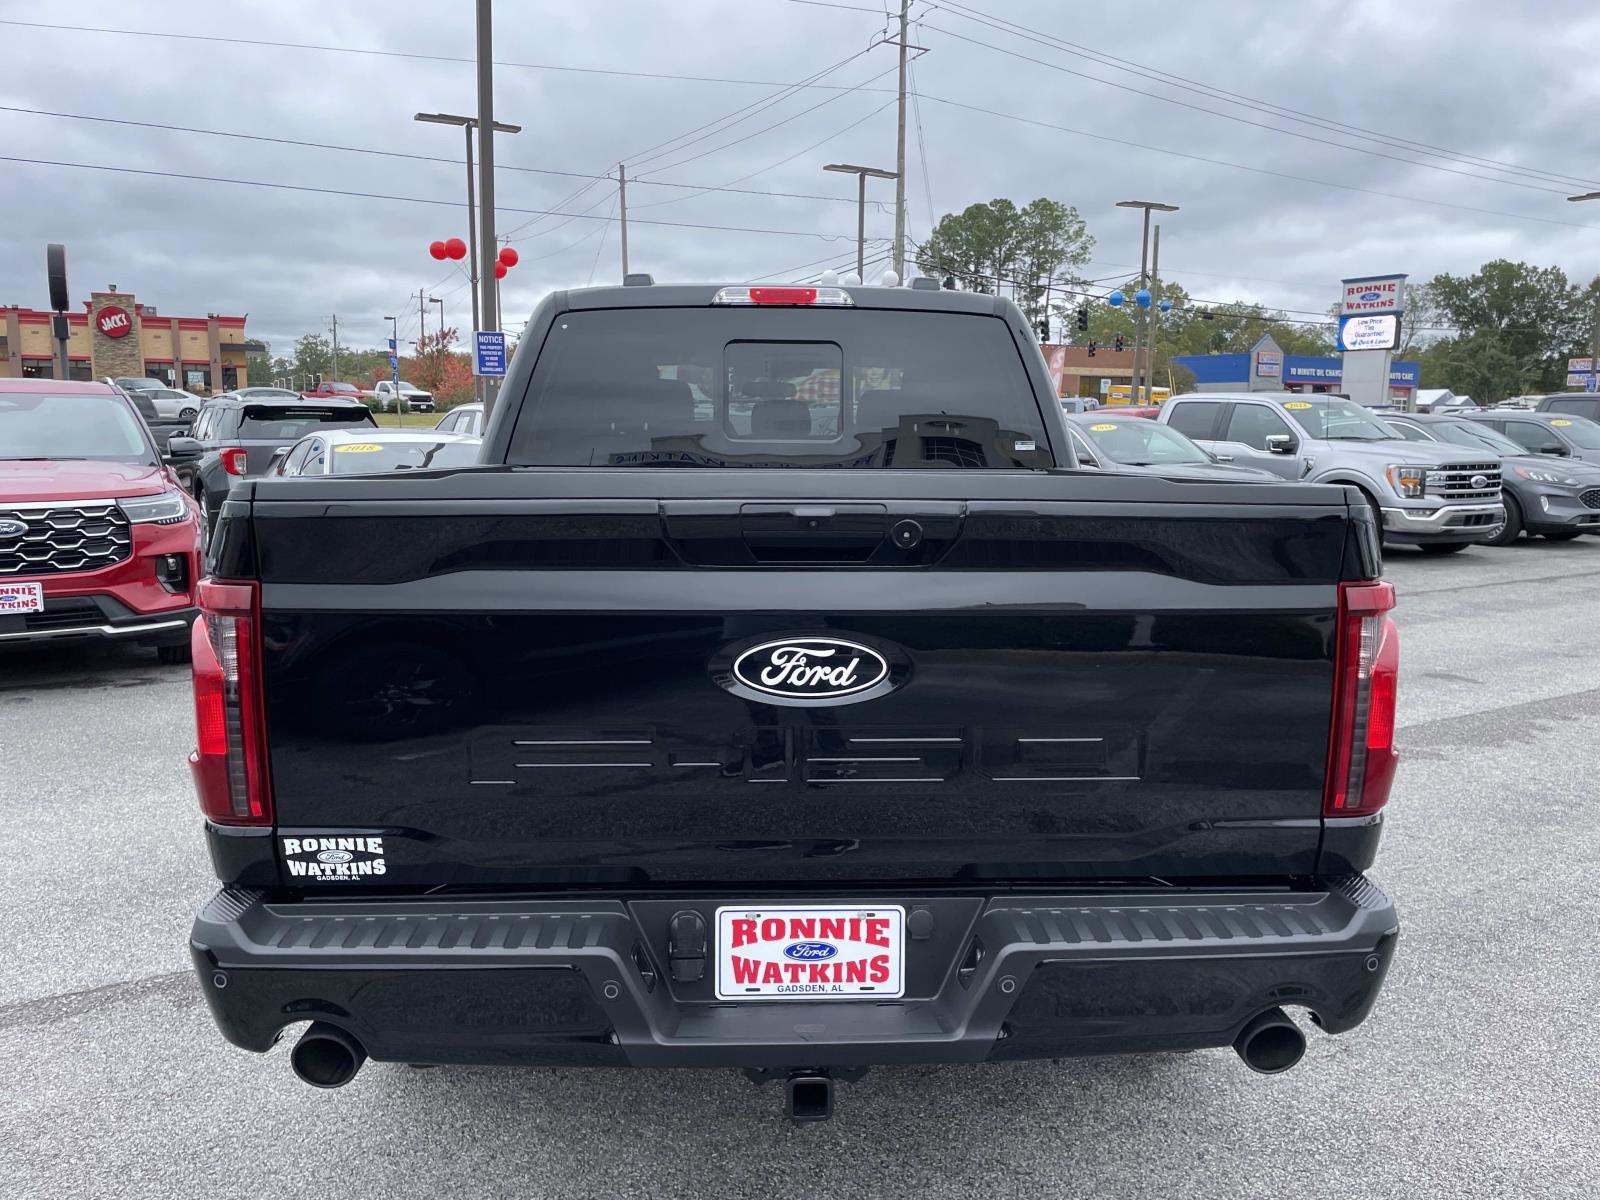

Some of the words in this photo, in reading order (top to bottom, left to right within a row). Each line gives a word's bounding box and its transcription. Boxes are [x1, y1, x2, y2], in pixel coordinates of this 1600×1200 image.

[1347, 284, 1396, 296] RONNIE
[1346, 299, 1395, 310] WATKINS
[478, 335, 503, 344] NOTICE
[1290, 367, 1296, 375] 10
[1297, 368, 1315, 376] MINUTE
[1325, 369, 1342, 377] CHANG
[1390, 372, 1401, 380] AUTO
[1401, 372, 1413, 380] CARE
[0, 587, 37, 596] NNIE
[0, 599, 38, 609] TKINS
[761, 647, 860, 686] Ford
[283, 837, 384, 856] RONNIE
[286, 858, 386, 876] WATKINS
[731, 918, 890, 949] RONNIE
[793, 944, 830, 958] Ford
[731, 954, 890, 985] WATKINS
[777, 985, 828, 993] GADSDEN,
